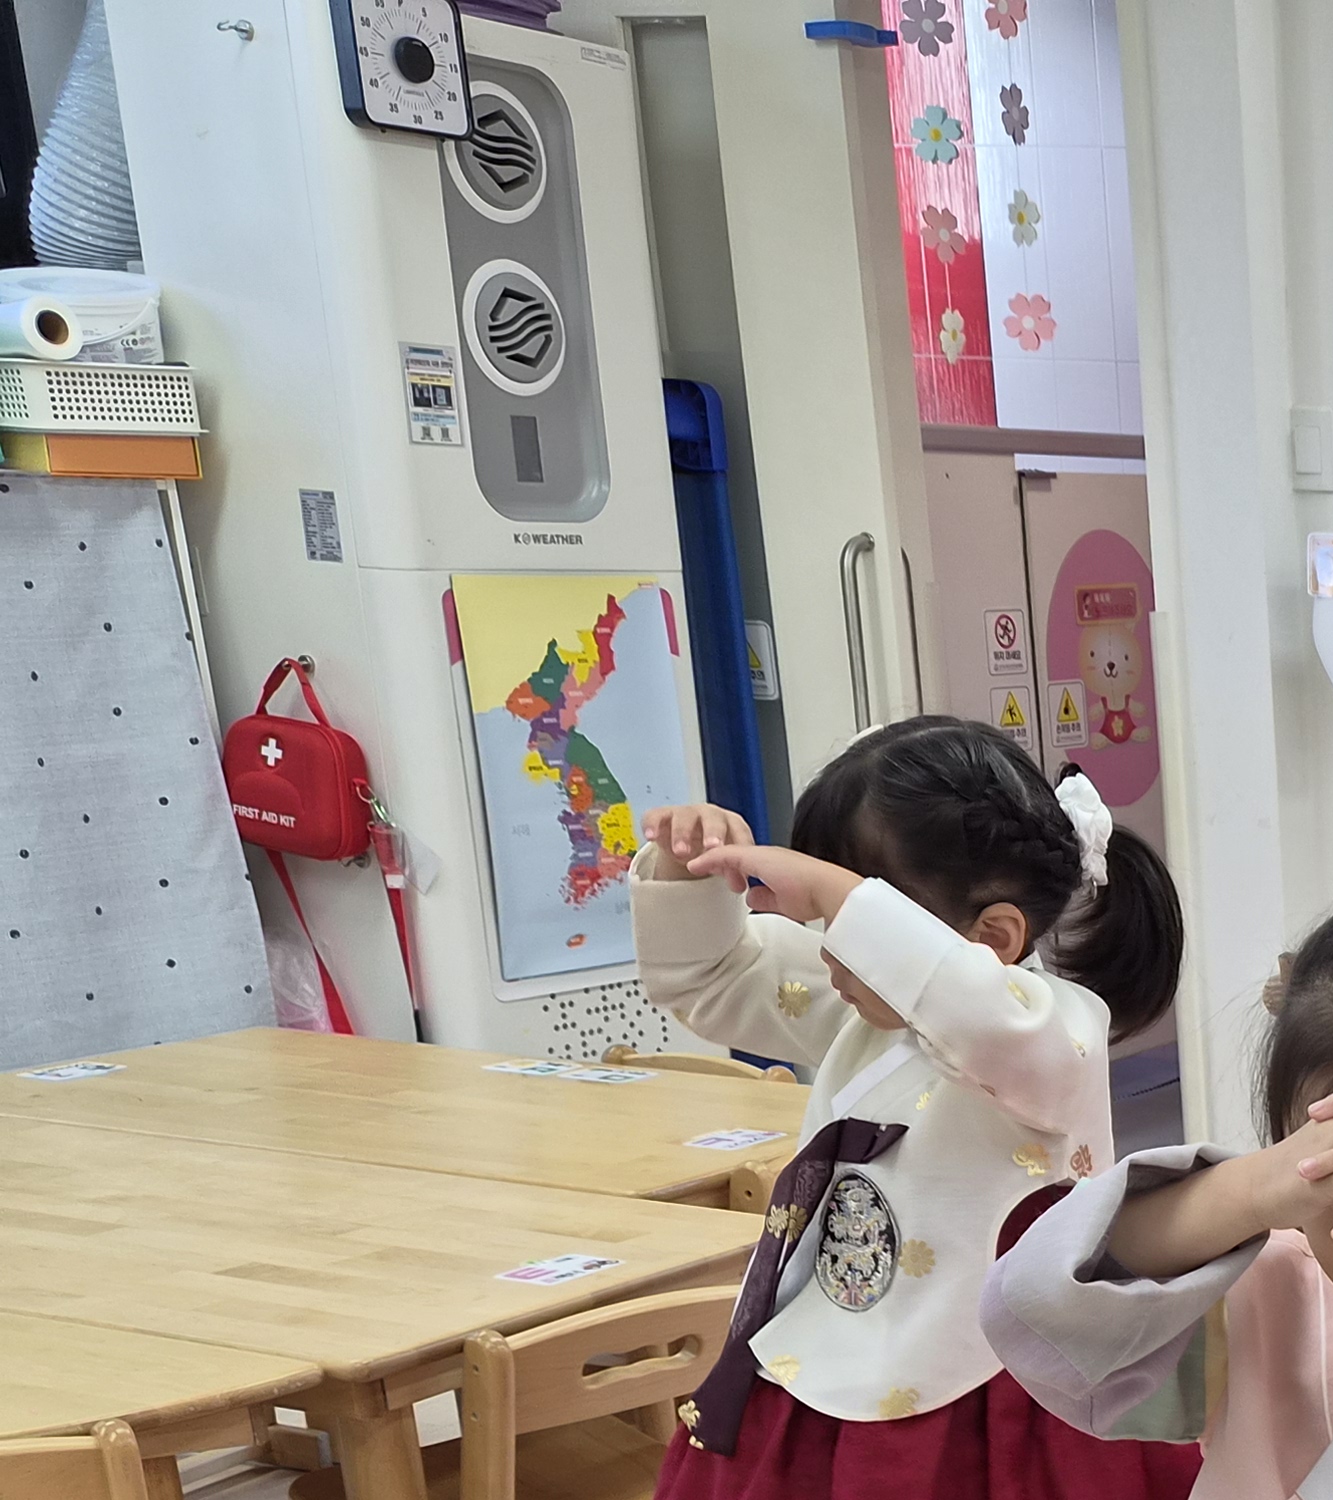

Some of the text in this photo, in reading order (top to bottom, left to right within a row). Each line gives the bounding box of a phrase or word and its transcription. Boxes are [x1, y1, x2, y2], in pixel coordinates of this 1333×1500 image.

[422, 7, 427, 18] 5
[361, 16, 371, 28] 50
[439, 33, 449, 43] 10
[359, 46, 369, 57] 45
[449, 63, 459, 74] 15
[369, 78, 379, 89] 40
[447, 91, 457, 102] 20
[389, 102, 399, 113] 35
[413, 115, 423, 125] 30
[434, 110, 444, 121] 25
[233, 803, 297, 829] FIRST AID KIT
